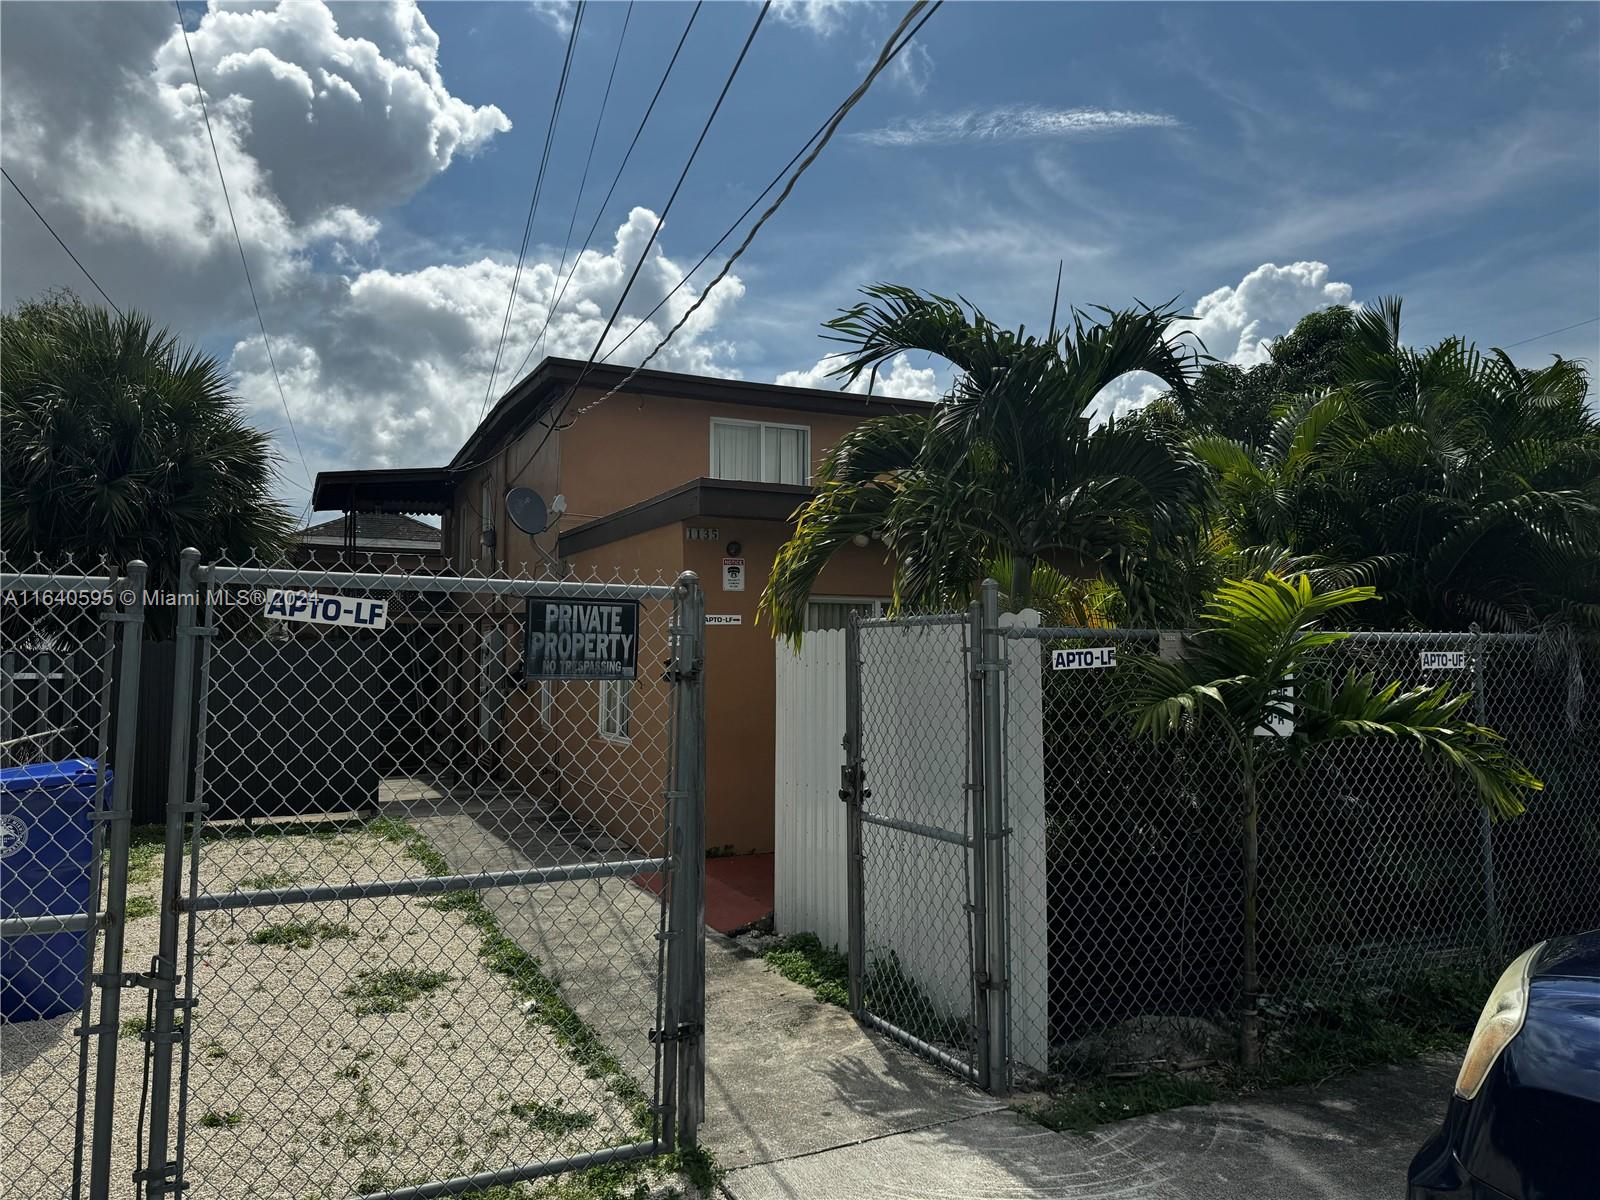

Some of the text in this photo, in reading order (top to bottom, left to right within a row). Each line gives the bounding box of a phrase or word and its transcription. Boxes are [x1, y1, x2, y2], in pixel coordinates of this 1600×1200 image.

[688, 528, 717, 539] 1135
[267, 593, 383, 625] APTO-LF
[545, 603, 622, 632] PRIVATE
[531, 632, 633, 659] PROPERTY
[542, 661, 622, 675] NO TRESPASSING
[1054, 651, 1115, 668] APTO-LF
[1423, 653, 1463, 667] APTO-UF
